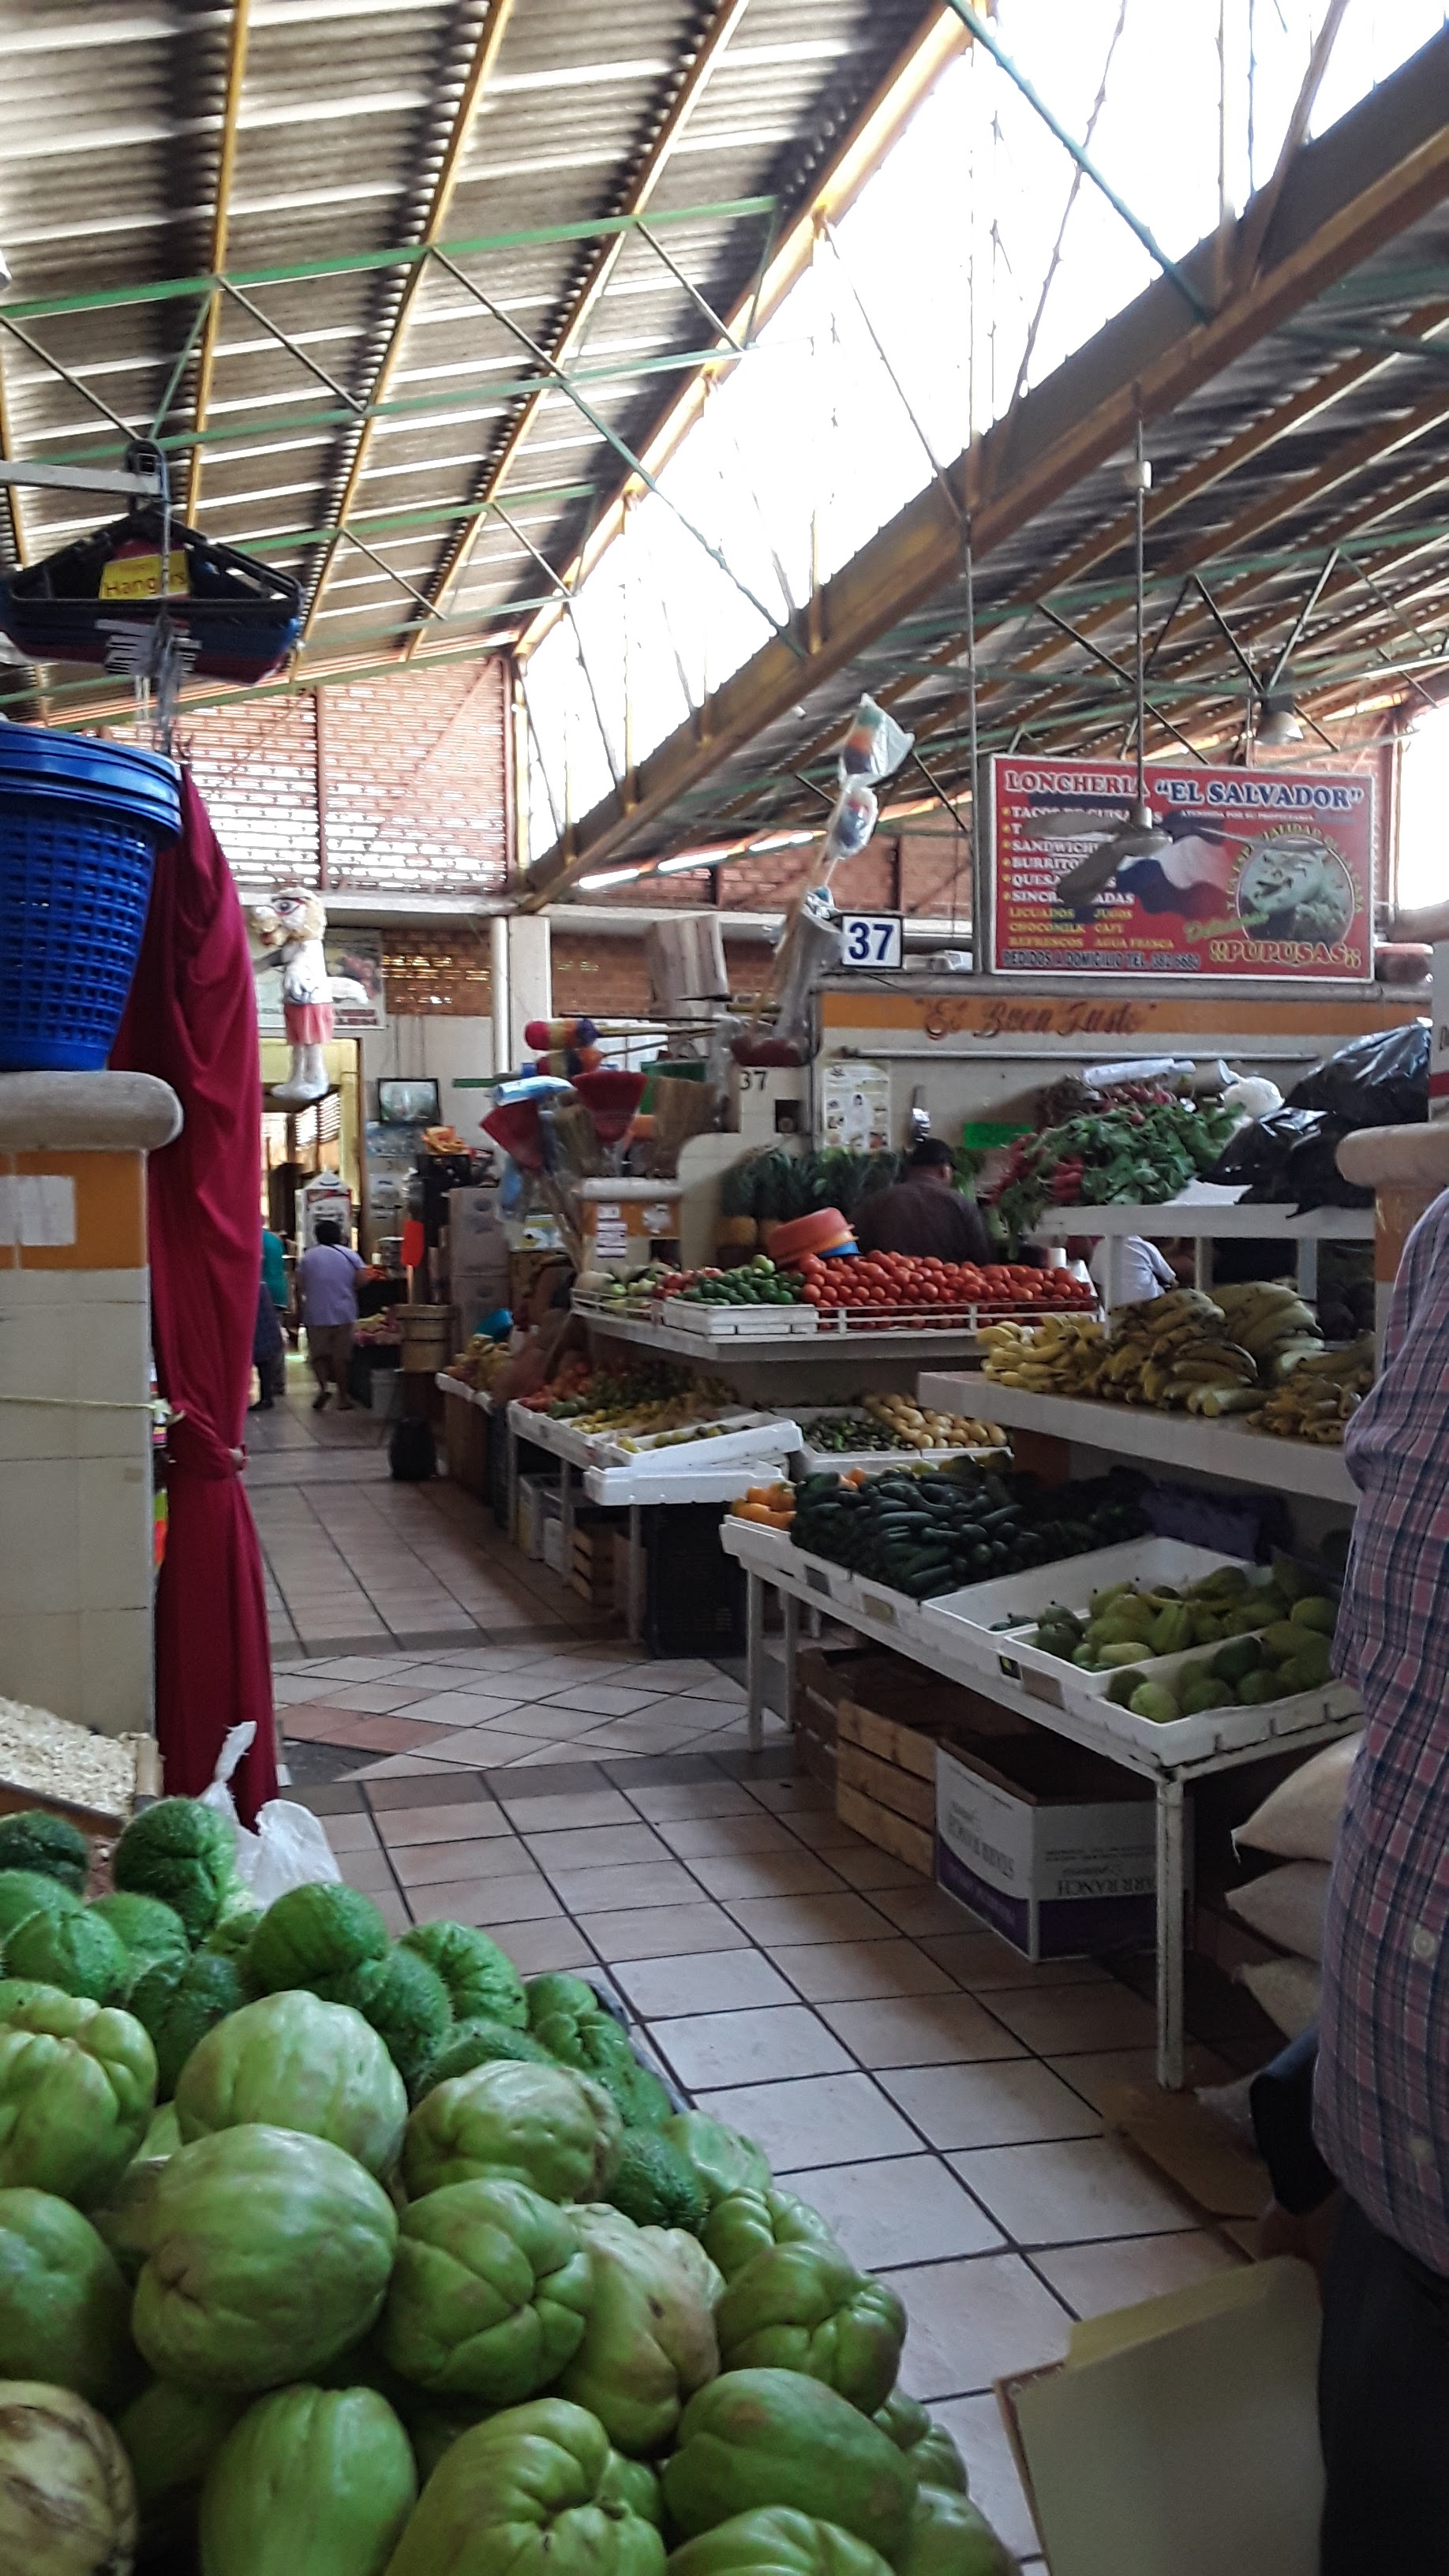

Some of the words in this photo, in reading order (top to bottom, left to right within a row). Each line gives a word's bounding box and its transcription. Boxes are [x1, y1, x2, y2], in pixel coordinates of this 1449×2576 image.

[1005, 770, 1150, 797] LONCHERIA
[1011, 840, 1099, 855] SANDWICH
[1011, 856, 1080, 871] BURRITO
[848, 922, 893, 960] 37
[740, 1070, 766, 1090] 37
